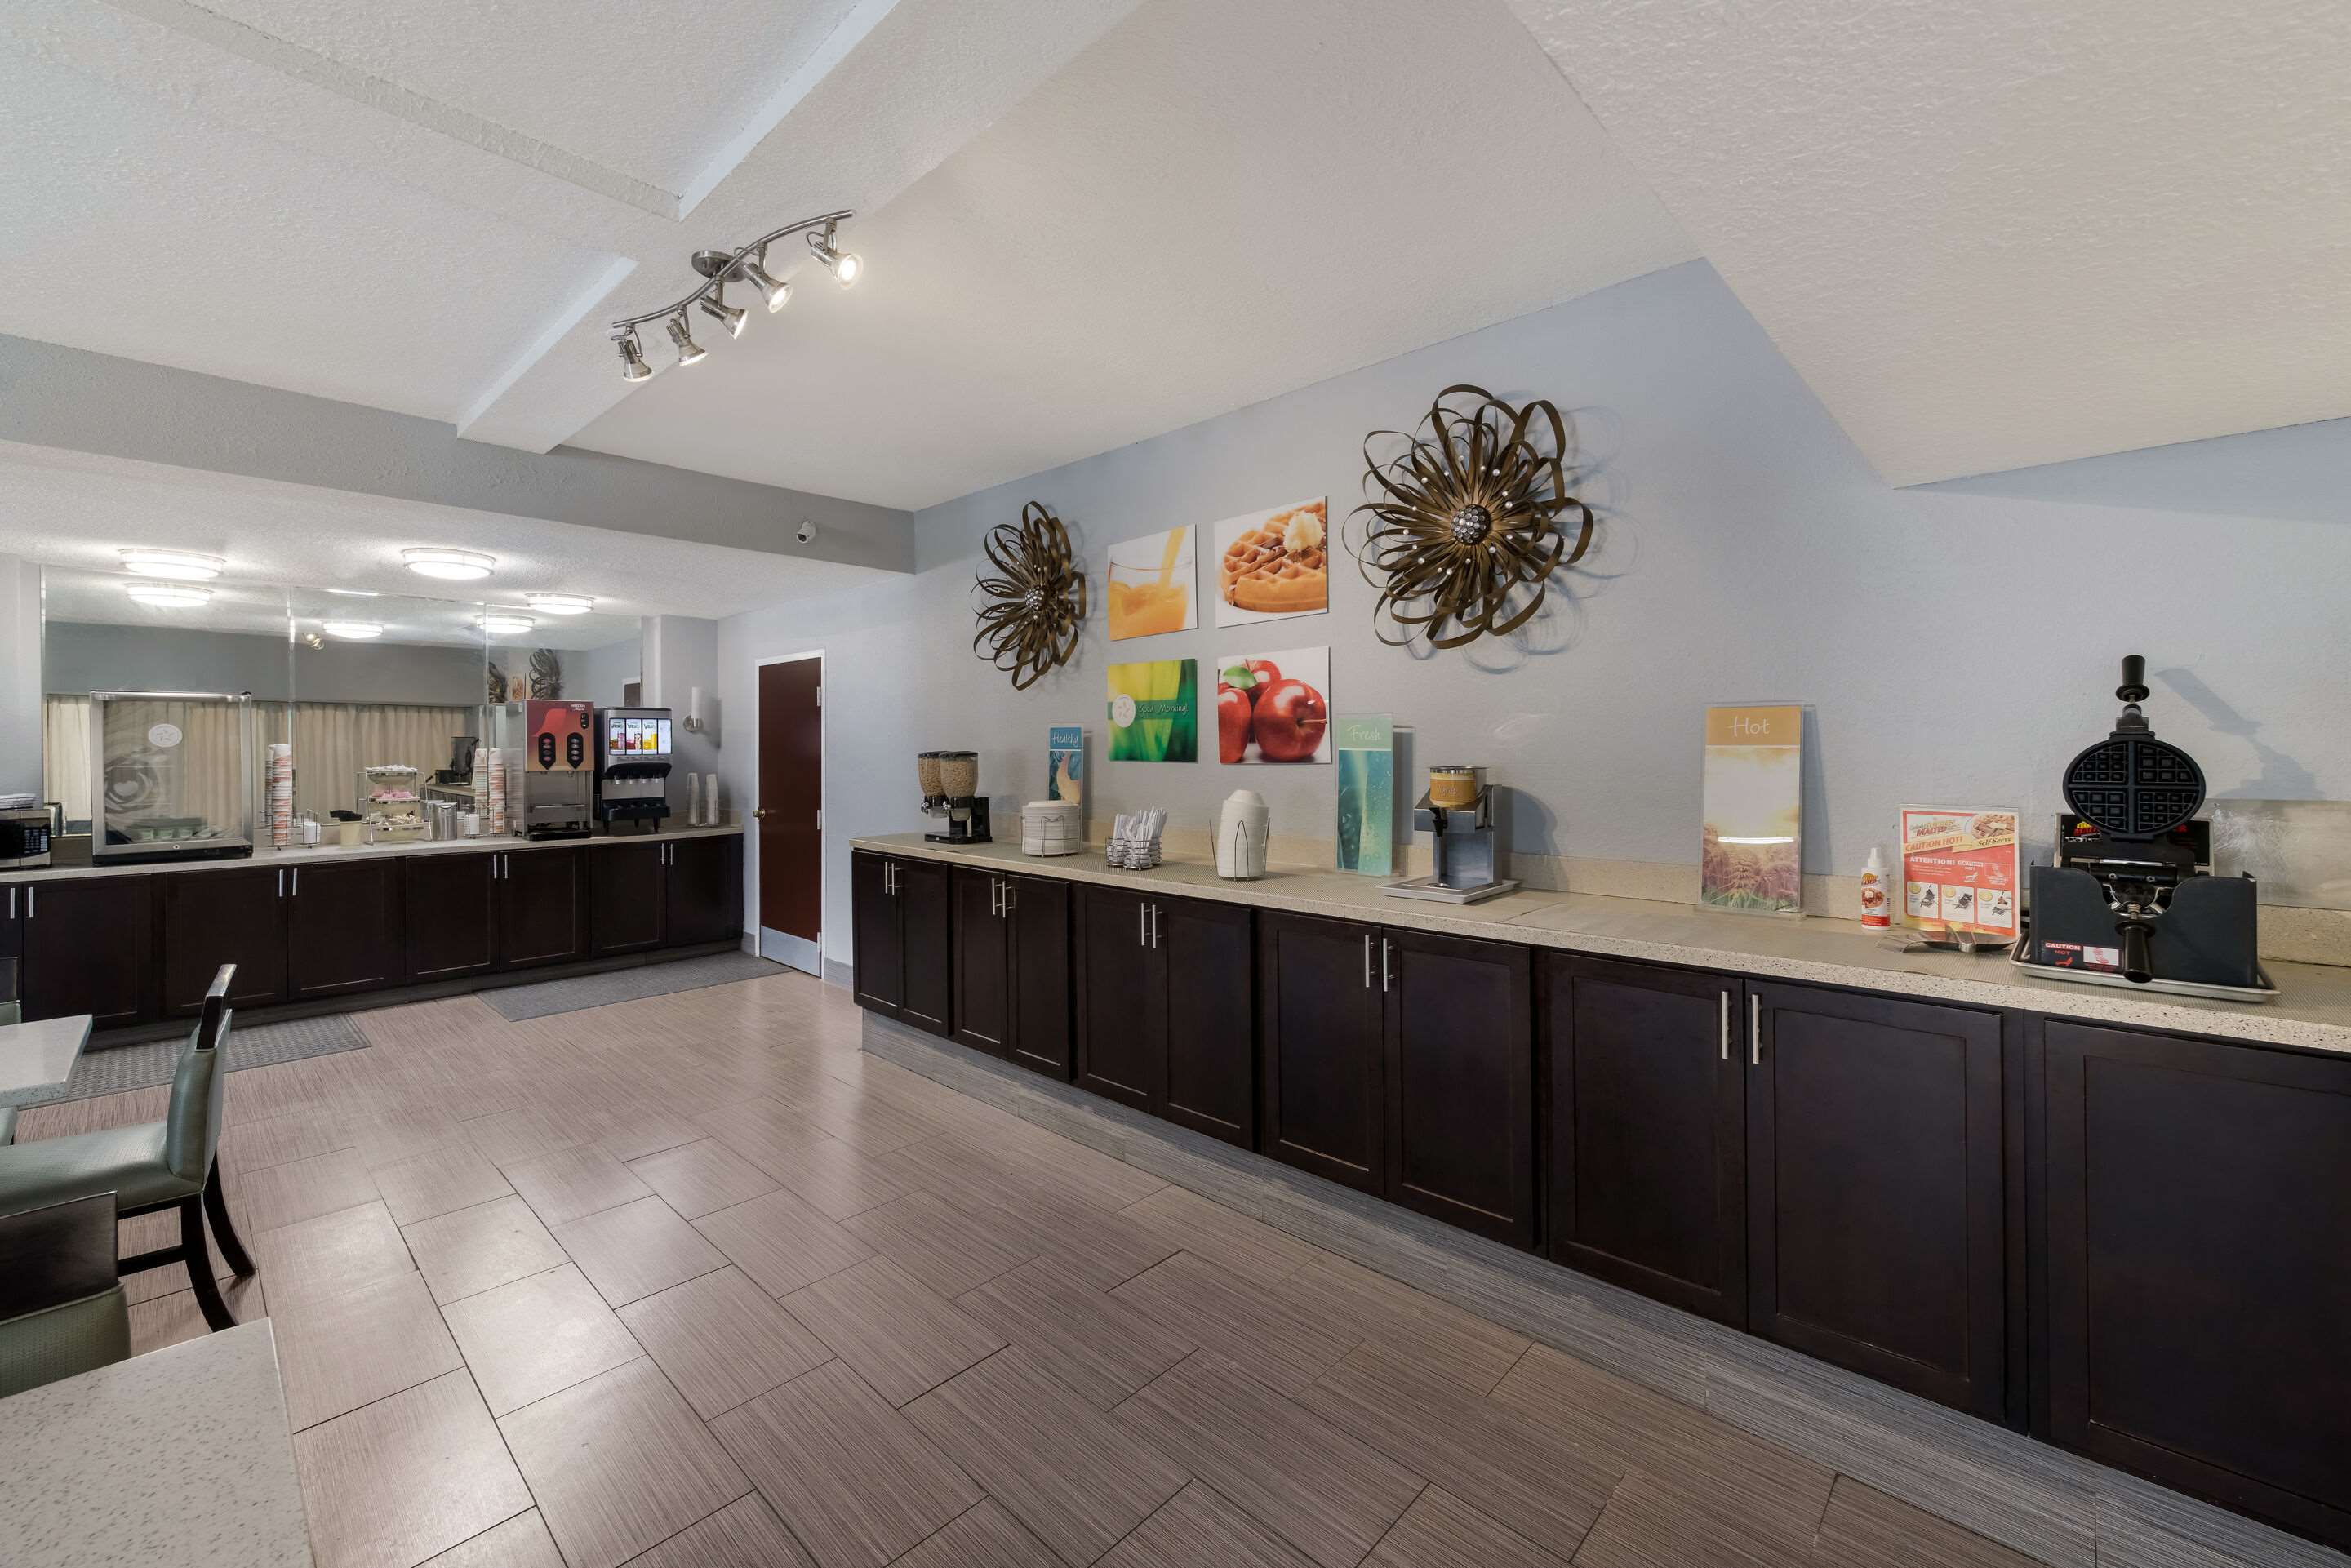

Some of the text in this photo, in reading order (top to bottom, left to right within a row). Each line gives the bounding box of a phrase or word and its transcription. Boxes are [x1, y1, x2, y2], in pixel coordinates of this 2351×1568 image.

[1345, 724, 1382, 742] Fresh
[1726, 716, 1771, 738] Hot
[1052, 731, 1079, 748] Healthy
[1905, 836, 1963, 851] CAUTION HOT!
[1910, 856, 1955, 866] ATTENTION!
[2045, 942, 2081, 951] CAUTION
